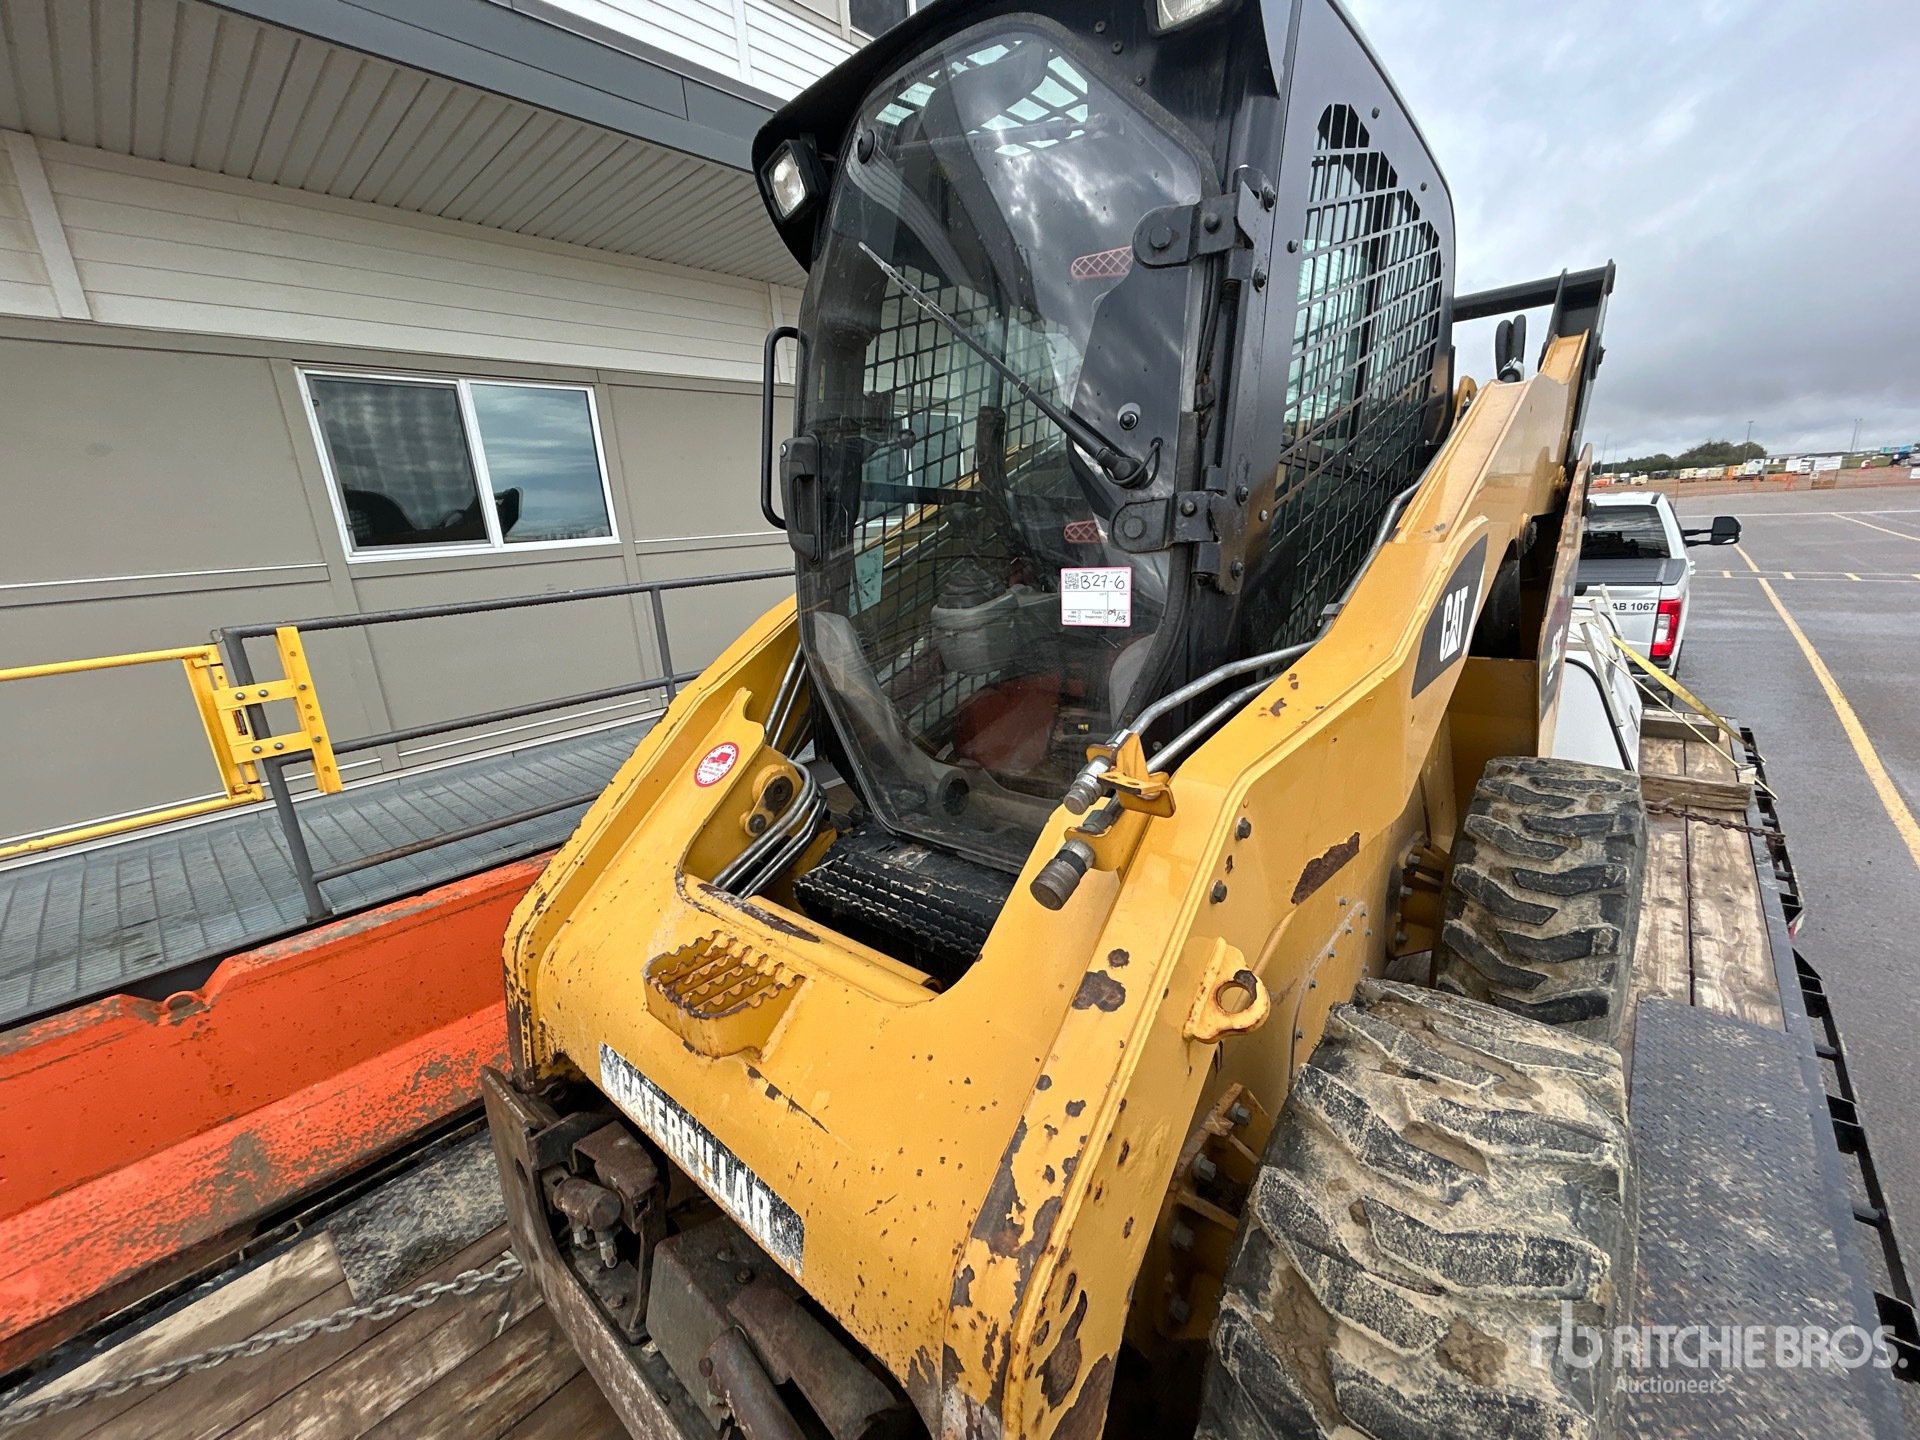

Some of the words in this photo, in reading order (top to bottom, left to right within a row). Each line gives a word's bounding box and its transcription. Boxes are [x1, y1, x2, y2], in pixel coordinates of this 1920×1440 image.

[1080, 574, 1125, 590] B27-6
[1439, 586, 1468, 662] CAT
[1630, 602, 1656, 611] 1067
[617, 1063, 773, 1246] CATERPILLAR
